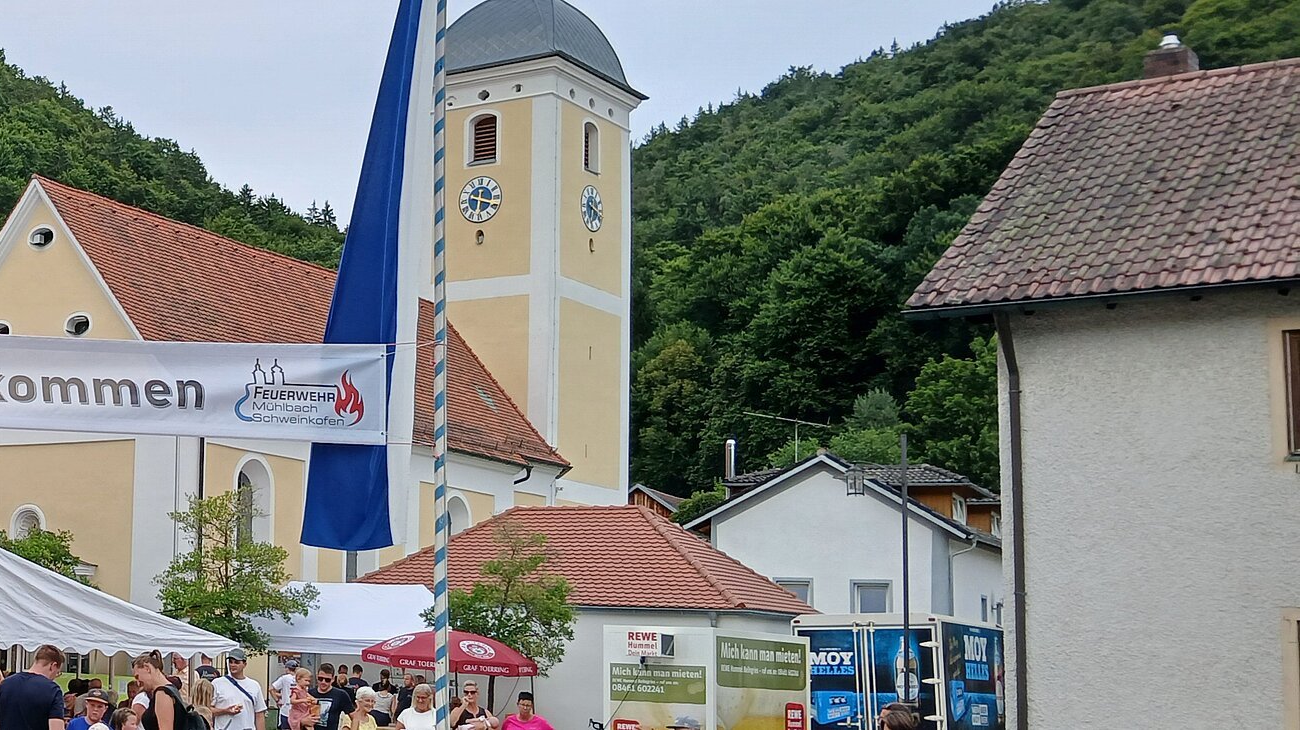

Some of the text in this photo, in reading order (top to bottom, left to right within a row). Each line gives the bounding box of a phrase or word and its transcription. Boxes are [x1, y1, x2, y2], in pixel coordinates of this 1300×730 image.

[253, 386, 336, 402] FEUERWEHR
[252, 401, 318, 413] Mühlbach
[252, 413, 345, 426] Schweinkofen
[628, 632, 657, 641] REWE
[720, 641, 801, 664] Mich kann man mieten!
[964, 635, 987, 662] MOY
[399, 658, 416, 668] GRAF
[810, 652, 853, 665] MOY
[463, 664, 478, 672] GRAF
[480, 665, 509, 674] TOERRING
[612, 666, 631, 676] Mich
[653, 669, 670, 678] man
[671, 669, 702, 679] mieten!
[810, 666, 855, 675] HELLES
[612, 683, 665, 693] 08461 602241
